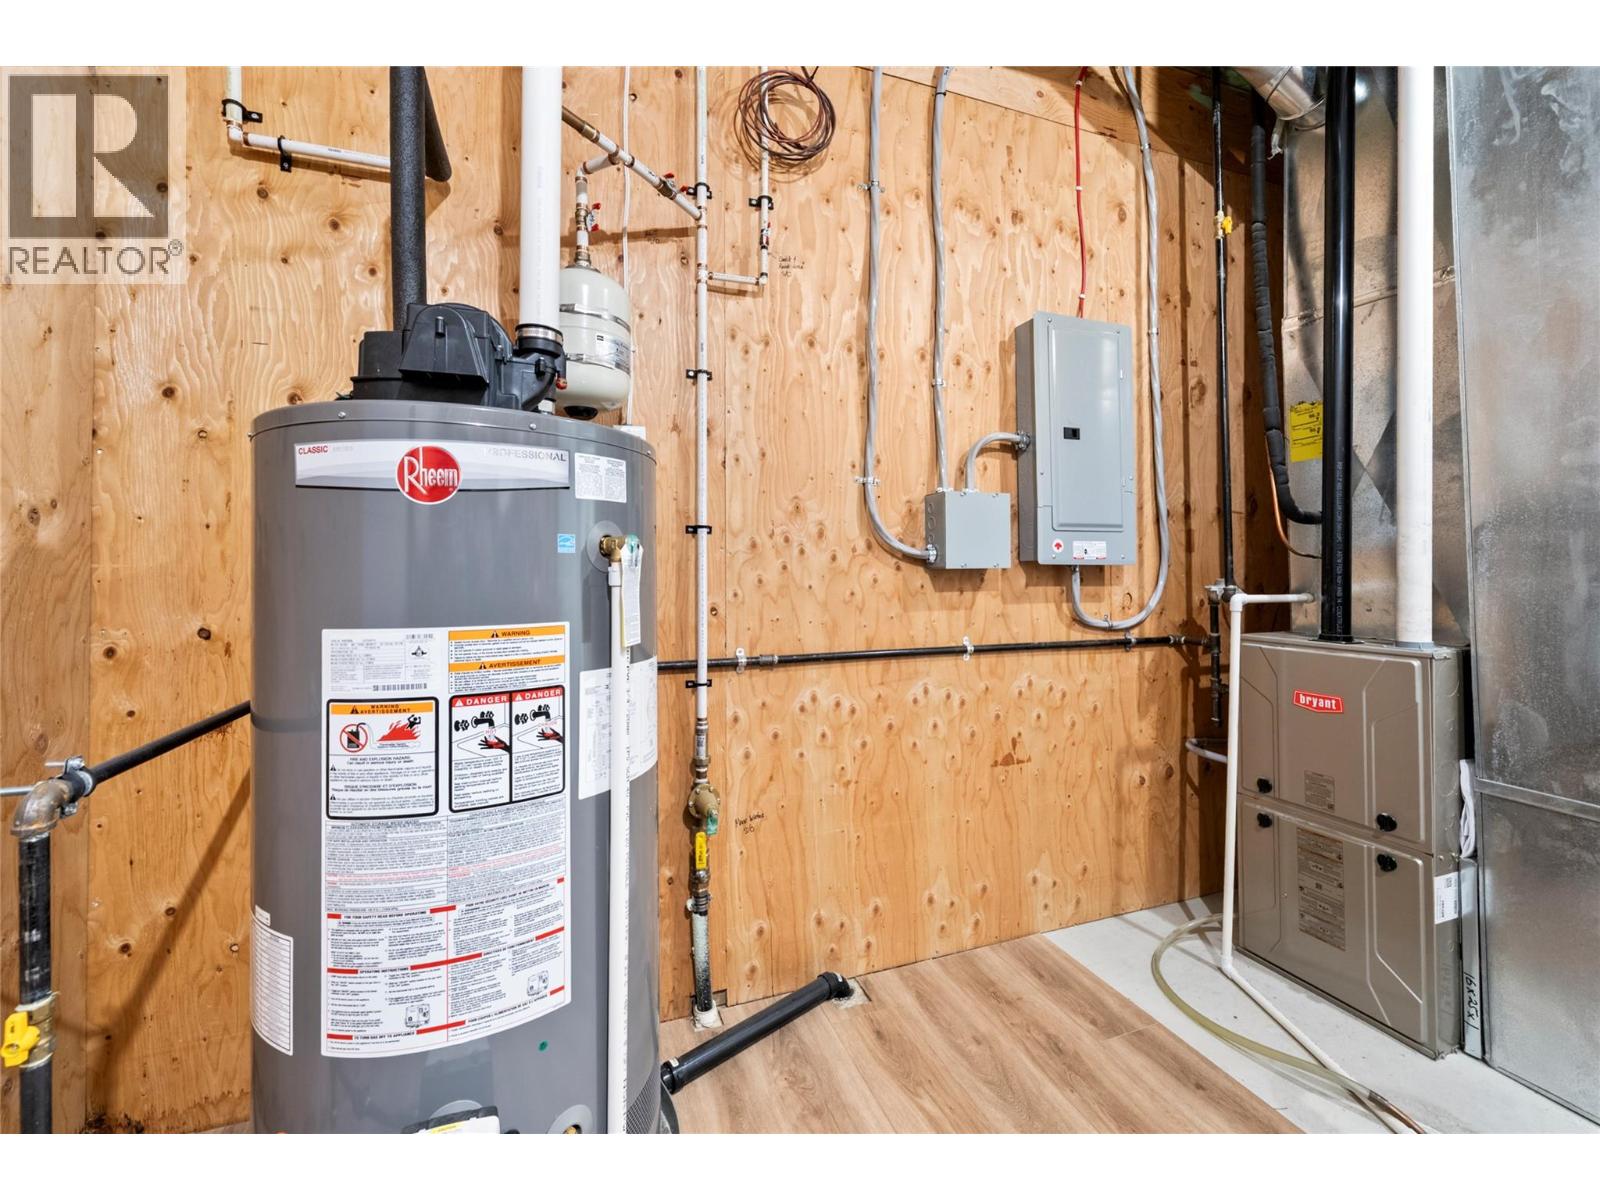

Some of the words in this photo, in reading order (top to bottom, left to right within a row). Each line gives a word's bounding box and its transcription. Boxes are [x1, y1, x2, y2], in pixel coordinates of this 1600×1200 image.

[298, 445, 328, 455] CLASSIC
[404, 447, 457, 494] Rheem
[489, 659, 541, 669] AVERTISSEMENT
[525, 688, 561, 700] DANGER
[466, 695, 507, 705] DANGER
[1299, 693, 1336, 710] bryant
